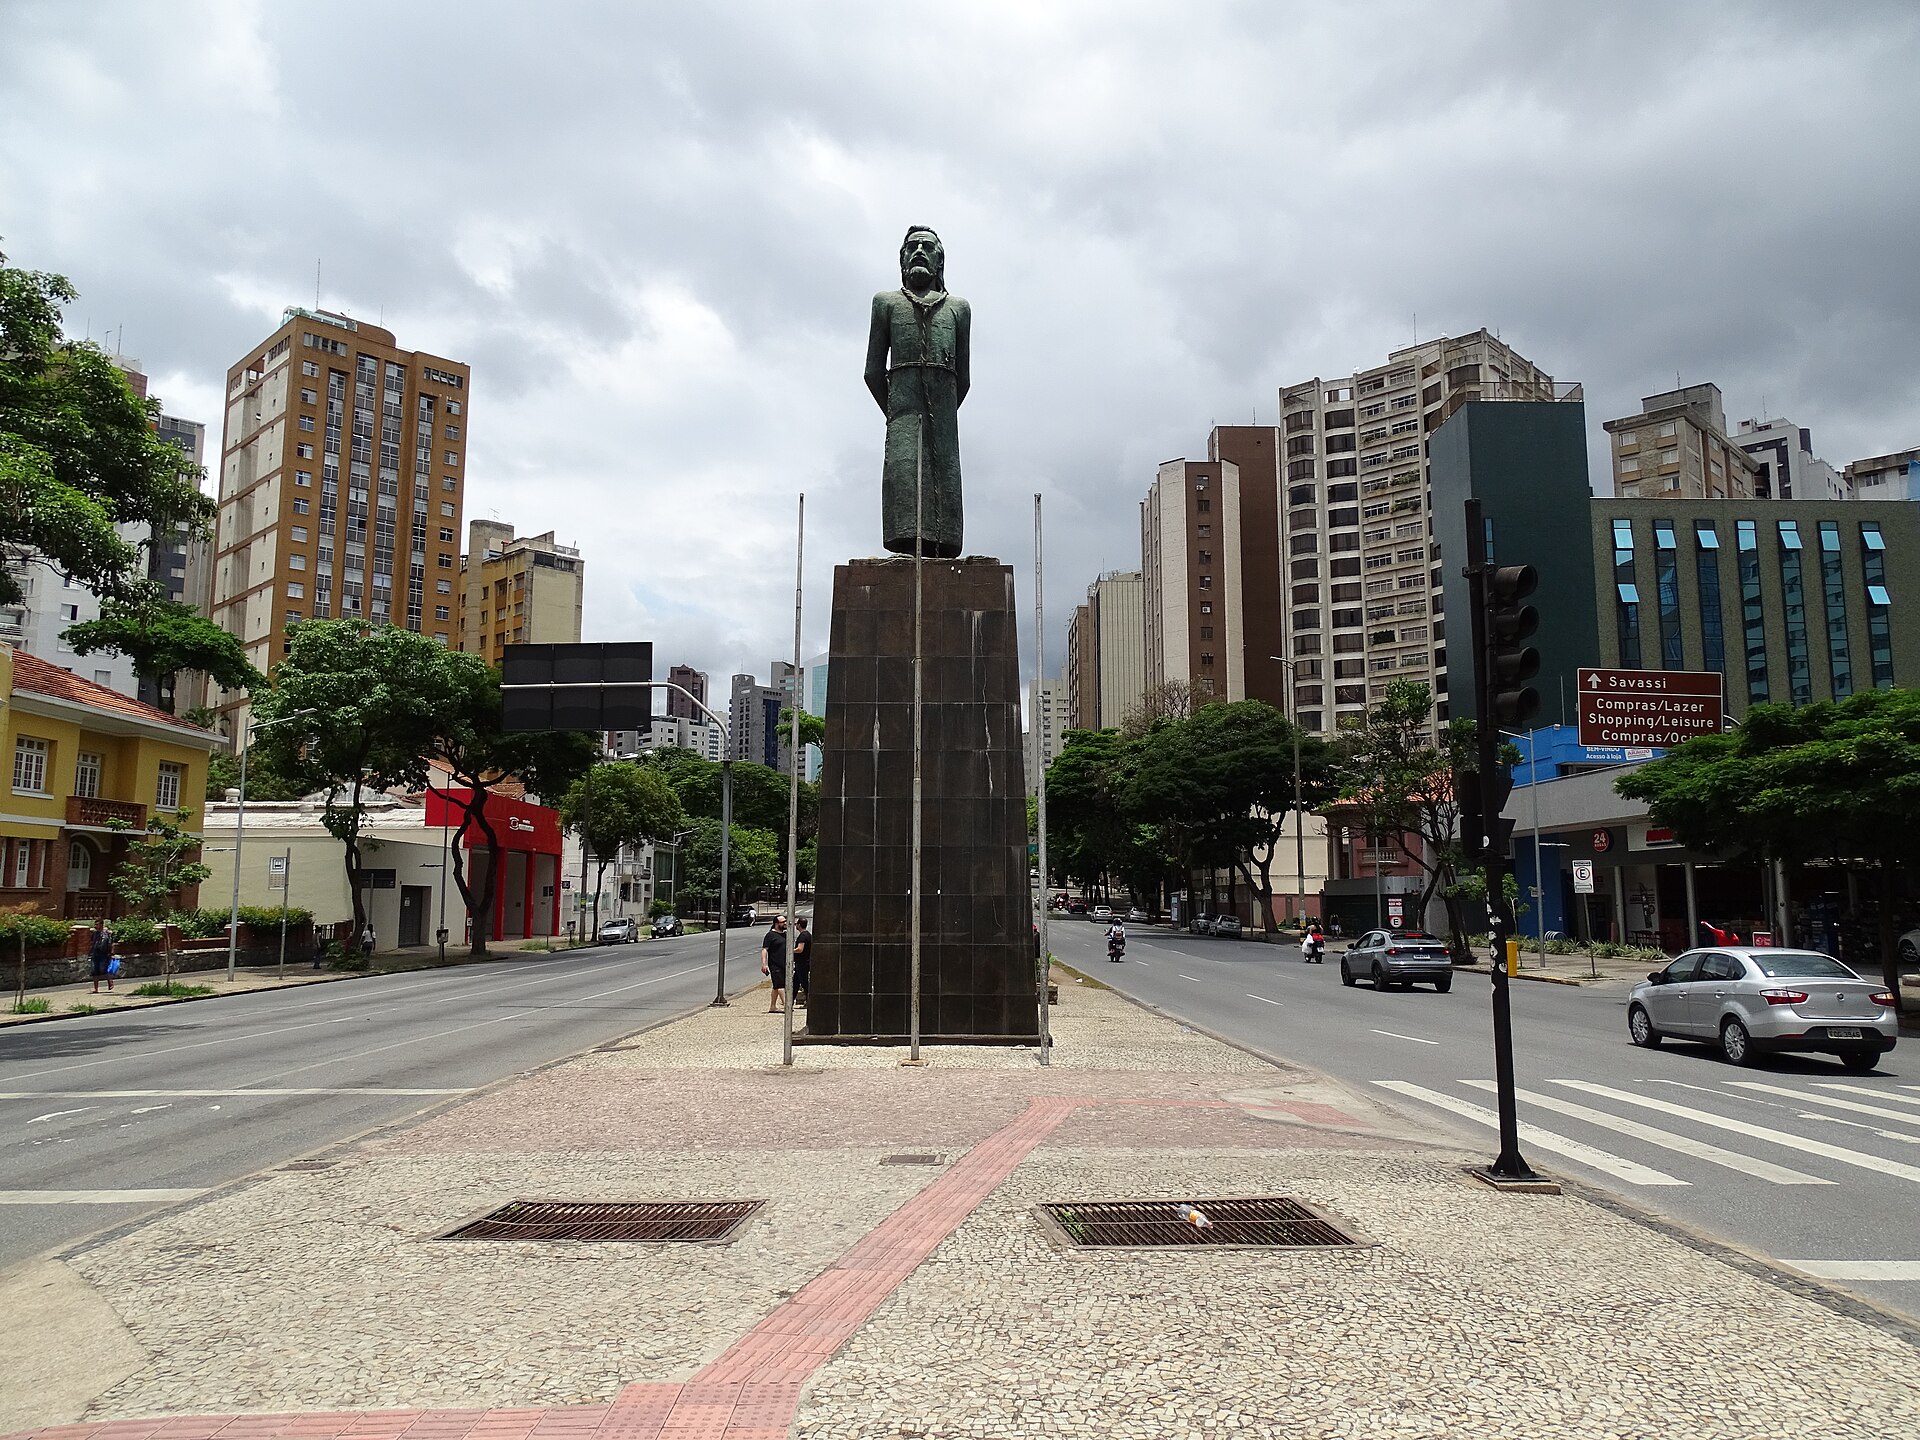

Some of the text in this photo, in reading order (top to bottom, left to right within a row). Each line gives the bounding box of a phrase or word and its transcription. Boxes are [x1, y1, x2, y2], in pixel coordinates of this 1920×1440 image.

[1609, 676, 1667, 689] Savassi
[1596, 698, 1705, 713] Compras/Lazer
[1588, 712, 1714, 729] Shopping/Leisure
[1594, 833, 1606, 843] 24
[1580, 869, 1586, 878] E
